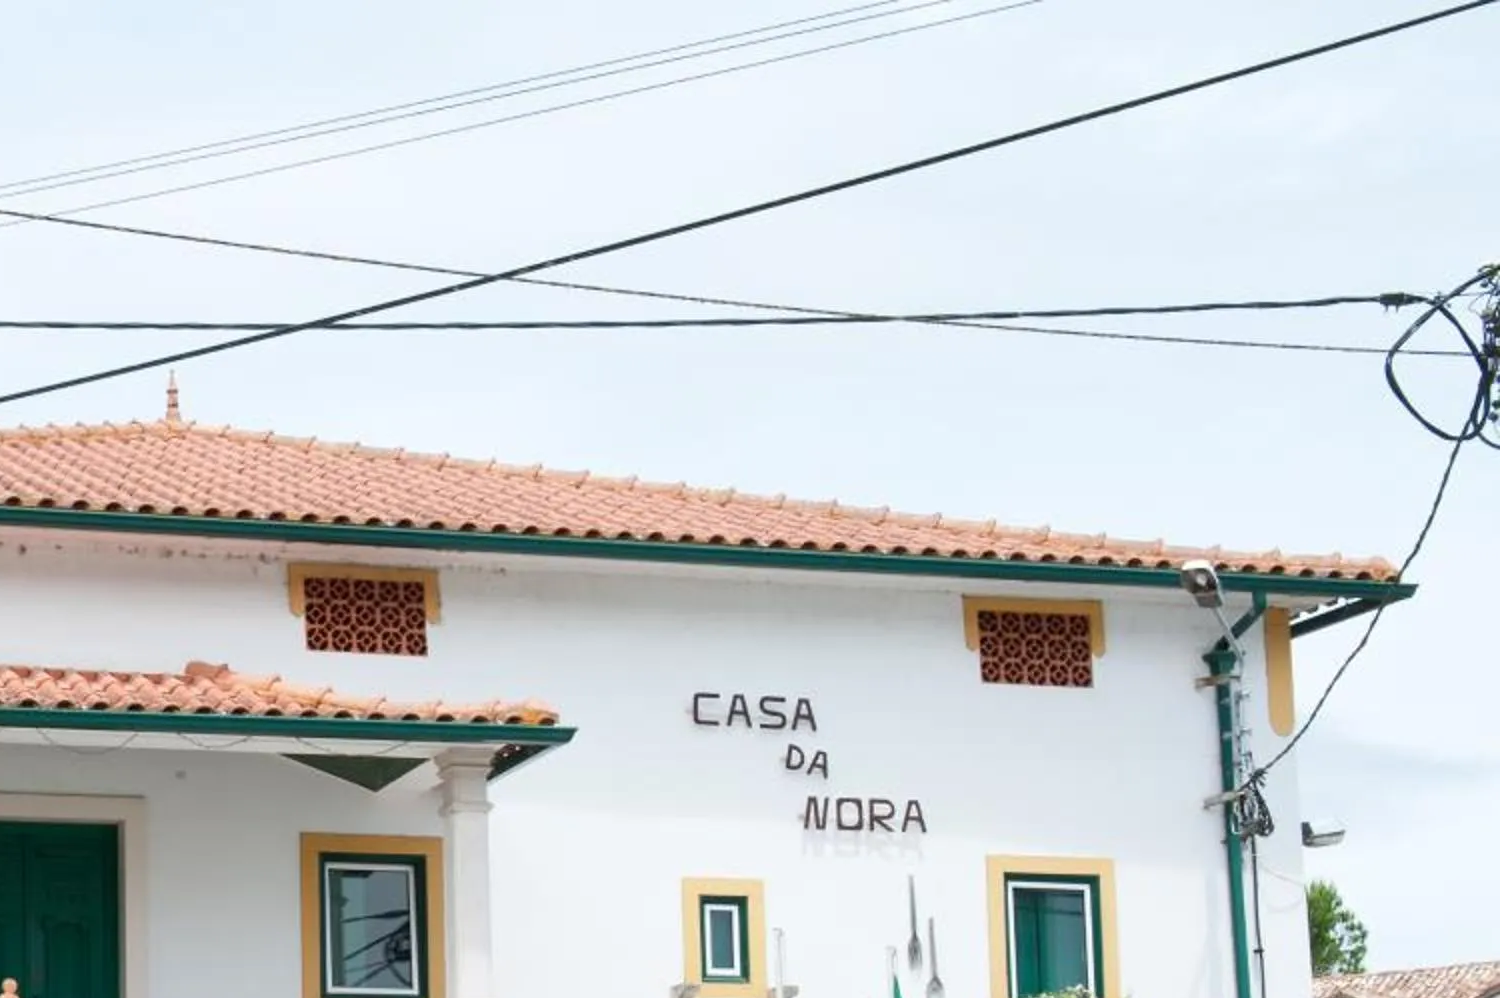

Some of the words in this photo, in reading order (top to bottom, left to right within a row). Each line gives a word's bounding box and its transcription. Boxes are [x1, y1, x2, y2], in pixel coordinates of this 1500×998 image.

[692, 692, 818, 733] CASA
[785, 743, 829, 780] DA
[802, 795, 928, 833] NORA
